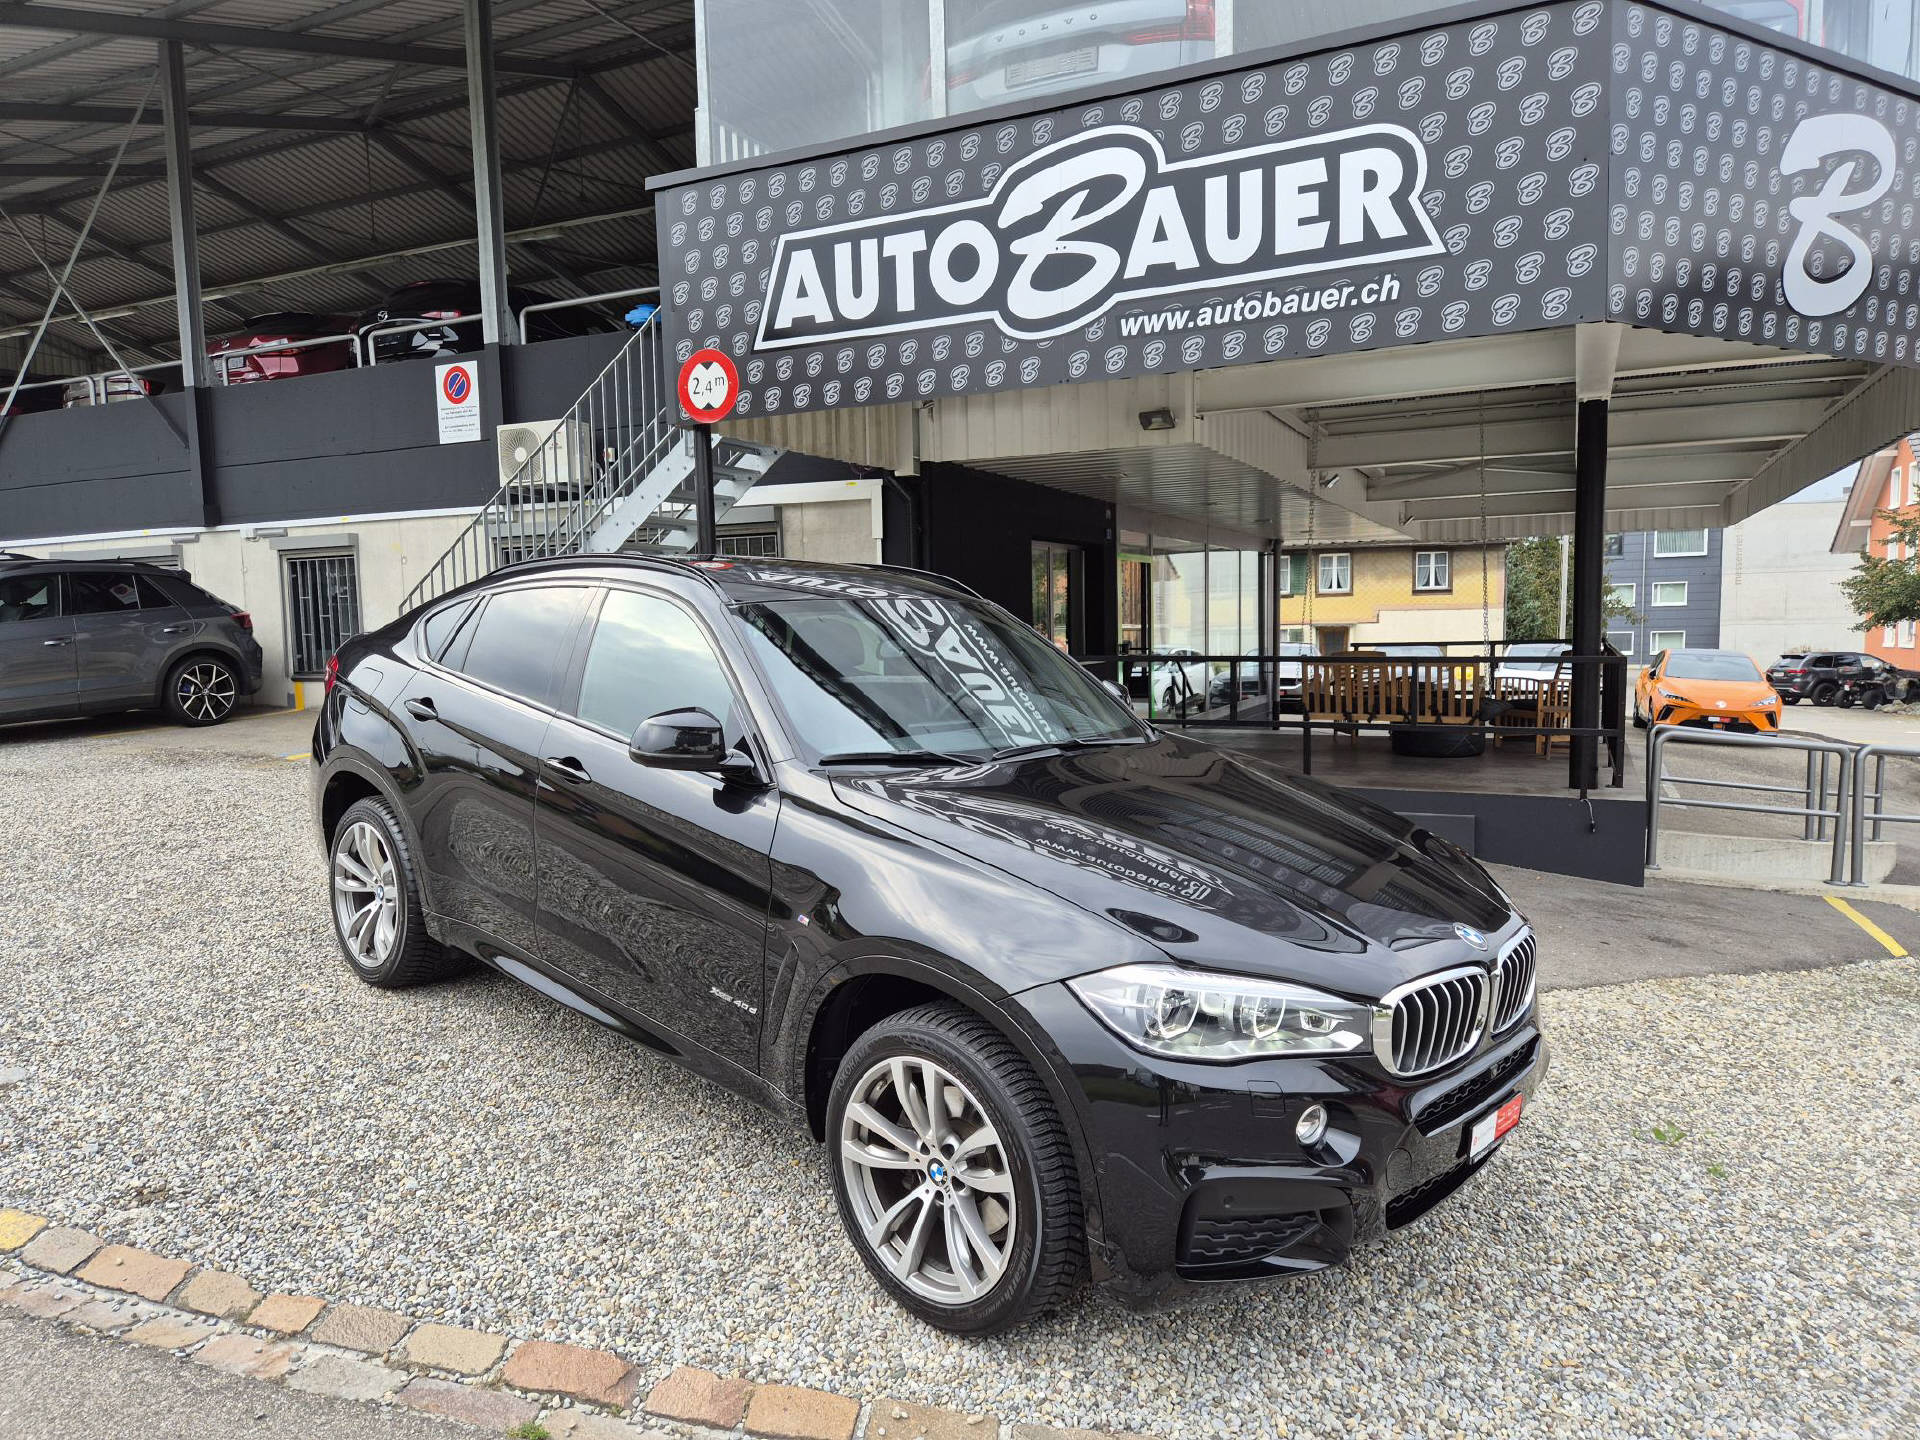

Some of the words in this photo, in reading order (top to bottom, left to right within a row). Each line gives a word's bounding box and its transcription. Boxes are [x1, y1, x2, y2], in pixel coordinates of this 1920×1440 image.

[994, 13, 1098, 42] VOLVO
[774, 146, 1409, 329] AUTOBAUER
[1780, 112, 1896, 317] B
[1120, 273, 1400, 337] www.autobauer.ch
